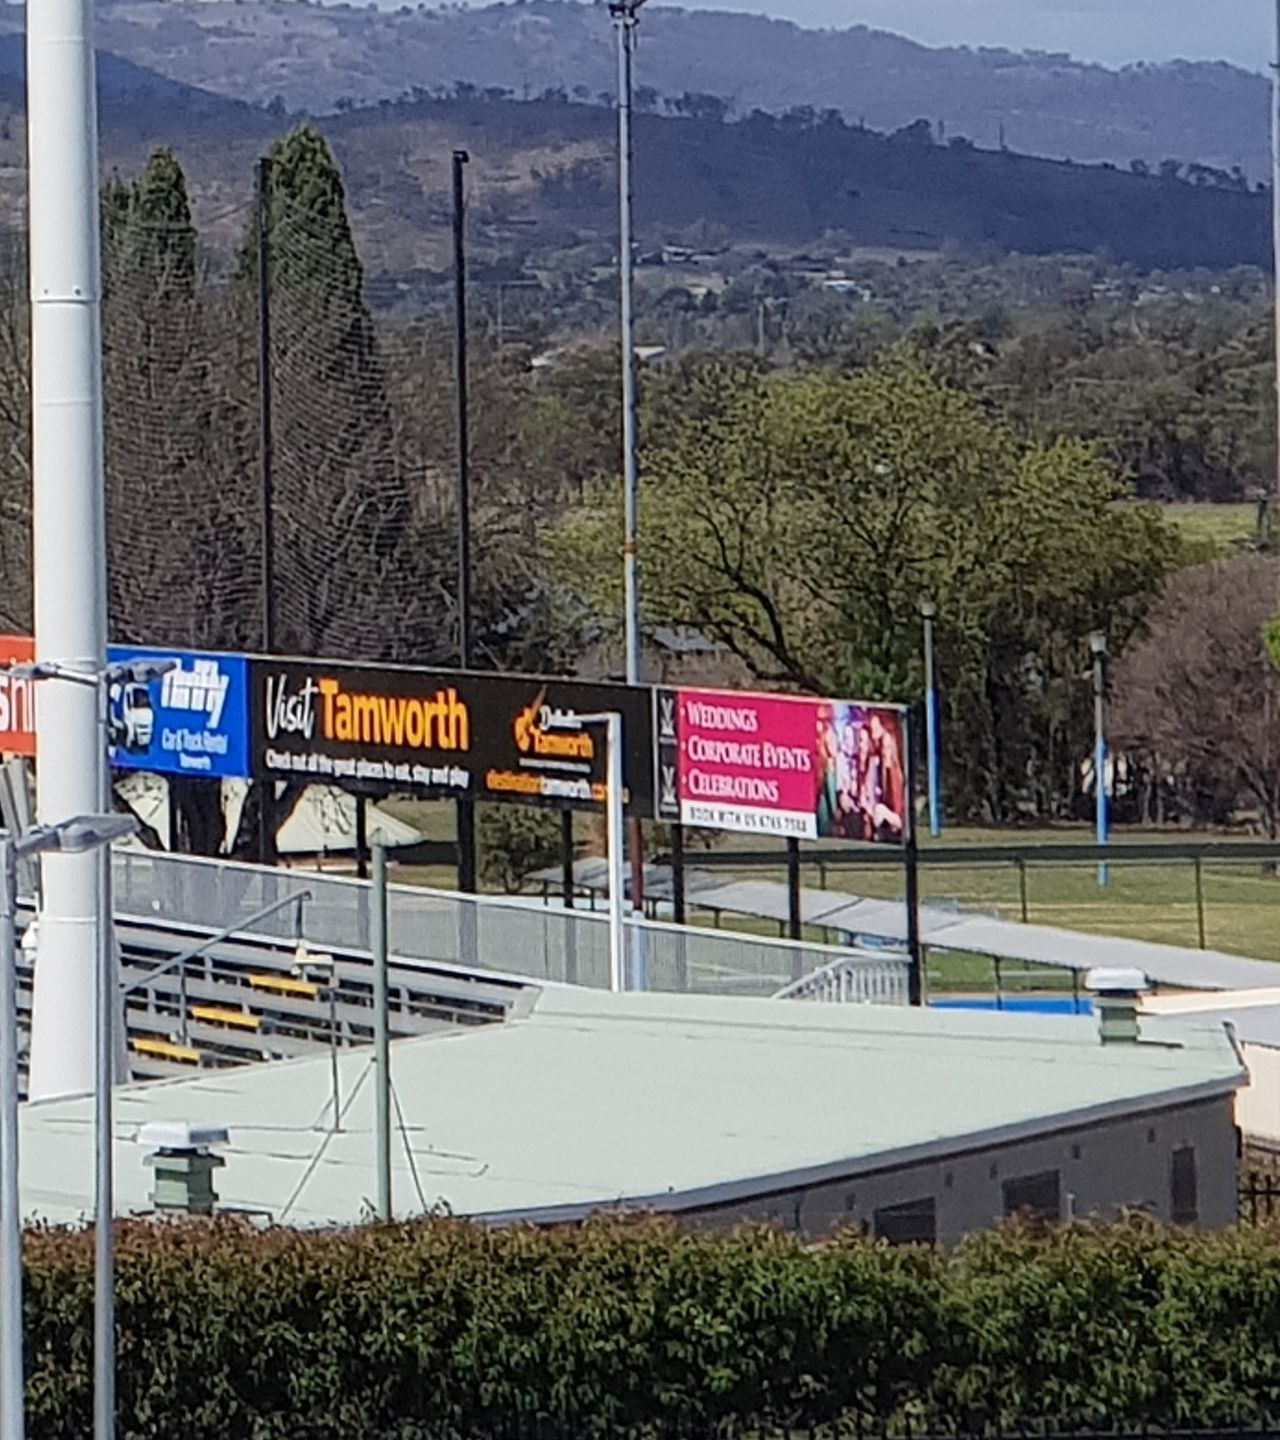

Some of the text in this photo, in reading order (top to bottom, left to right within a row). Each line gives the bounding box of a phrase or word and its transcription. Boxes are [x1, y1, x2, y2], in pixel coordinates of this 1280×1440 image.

[266, 673, 469, 750] Visit Tamworth
[686, 701, 759, 732] WEDDINGS
[265, 748, 291, 770] Check
[333, 757, 356, 778] great
[356, 758, 384, 779] places
[432, 765, 448, 784] and
[687, 735, 811, 772] CORPORATE EVENTS
[688, 768, 779, 803] CELEBRATIONS
